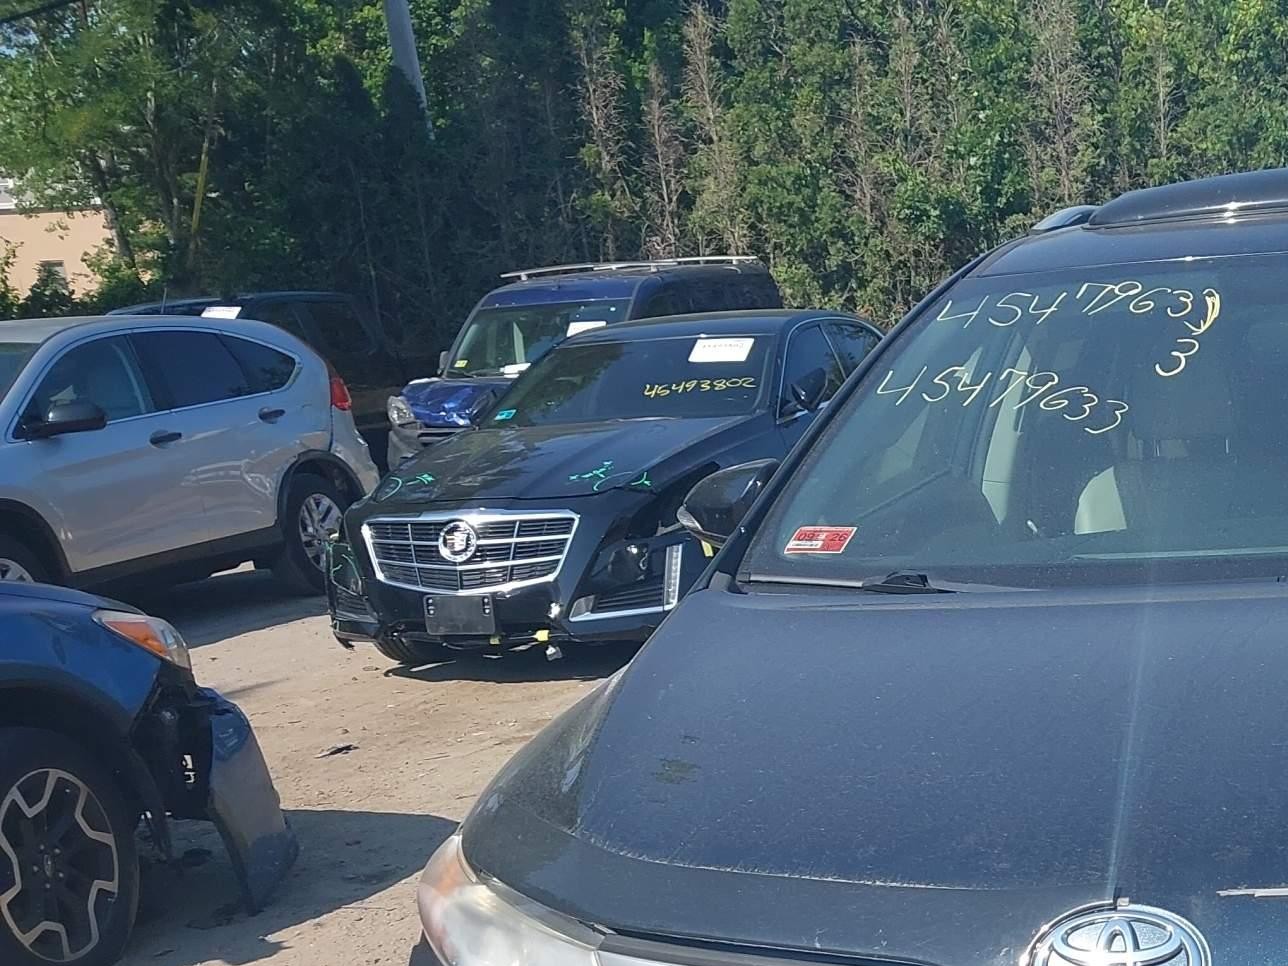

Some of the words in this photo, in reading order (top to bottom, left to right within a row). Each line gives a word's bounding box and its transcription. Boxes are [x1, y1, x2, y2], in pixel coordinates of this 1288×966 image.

[1155, 338, 1199, 376] 3
[643, 377, 756, 398] 45493802
[876, 366, 1129, 434] 45479633
